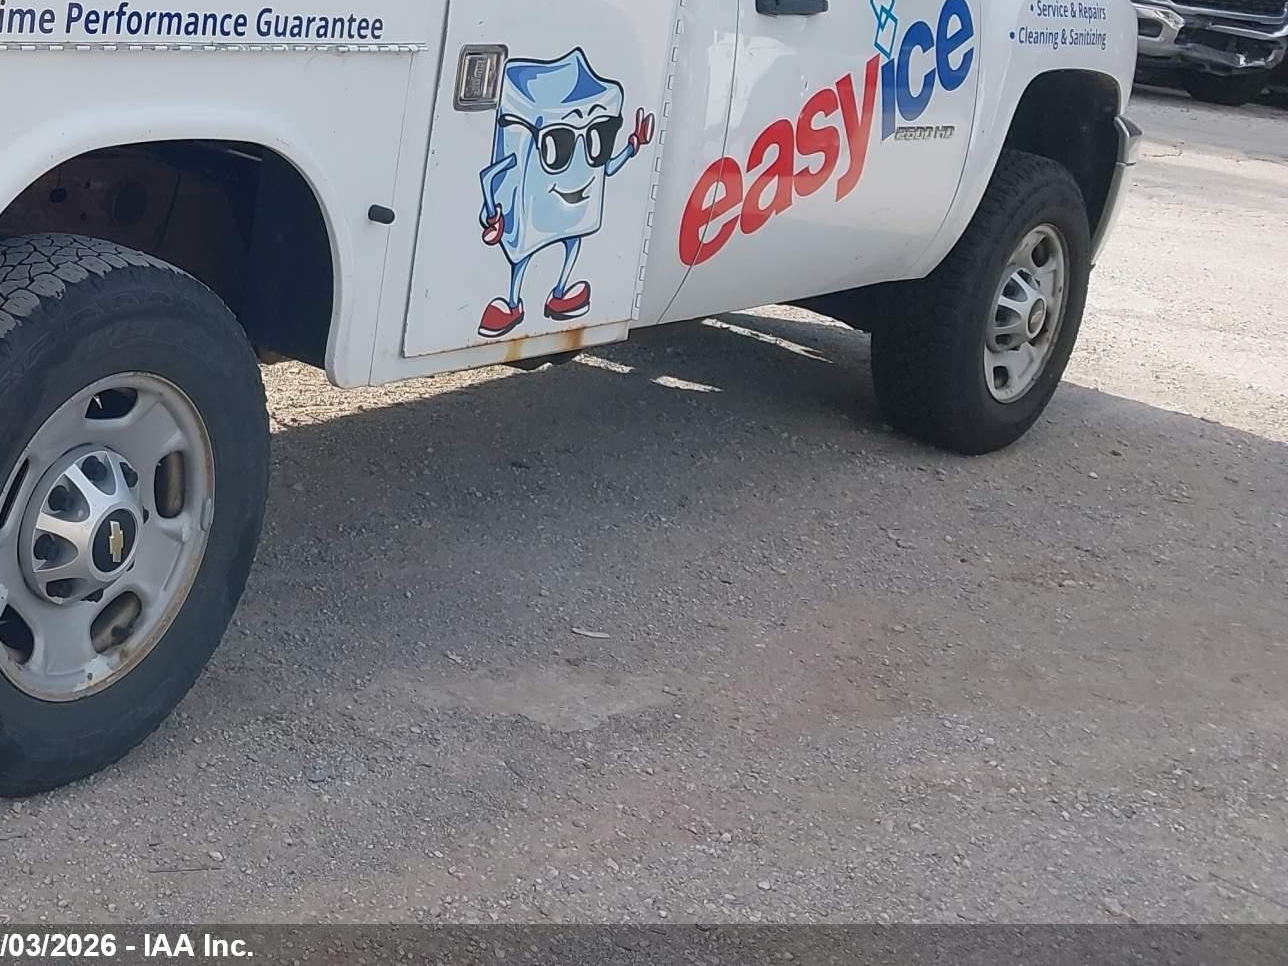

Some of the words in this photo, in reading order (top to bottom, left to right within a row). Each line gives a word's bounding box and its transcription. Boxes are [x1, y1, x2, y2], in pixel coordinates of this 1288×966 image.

[65, 2, 248, 36] Performance
[257, 8, 384, 40] Guarantee
[1037, 0, 1069, 18] Service
[1070, 4, 1077, 18] &
[1078, 3, 1106, 25] Repairs
[1018, 27, 1059, 50] Cleaning
[1061, 29, 1067, 45] &
[1069, 29, 1107, 50] Sanitizing
